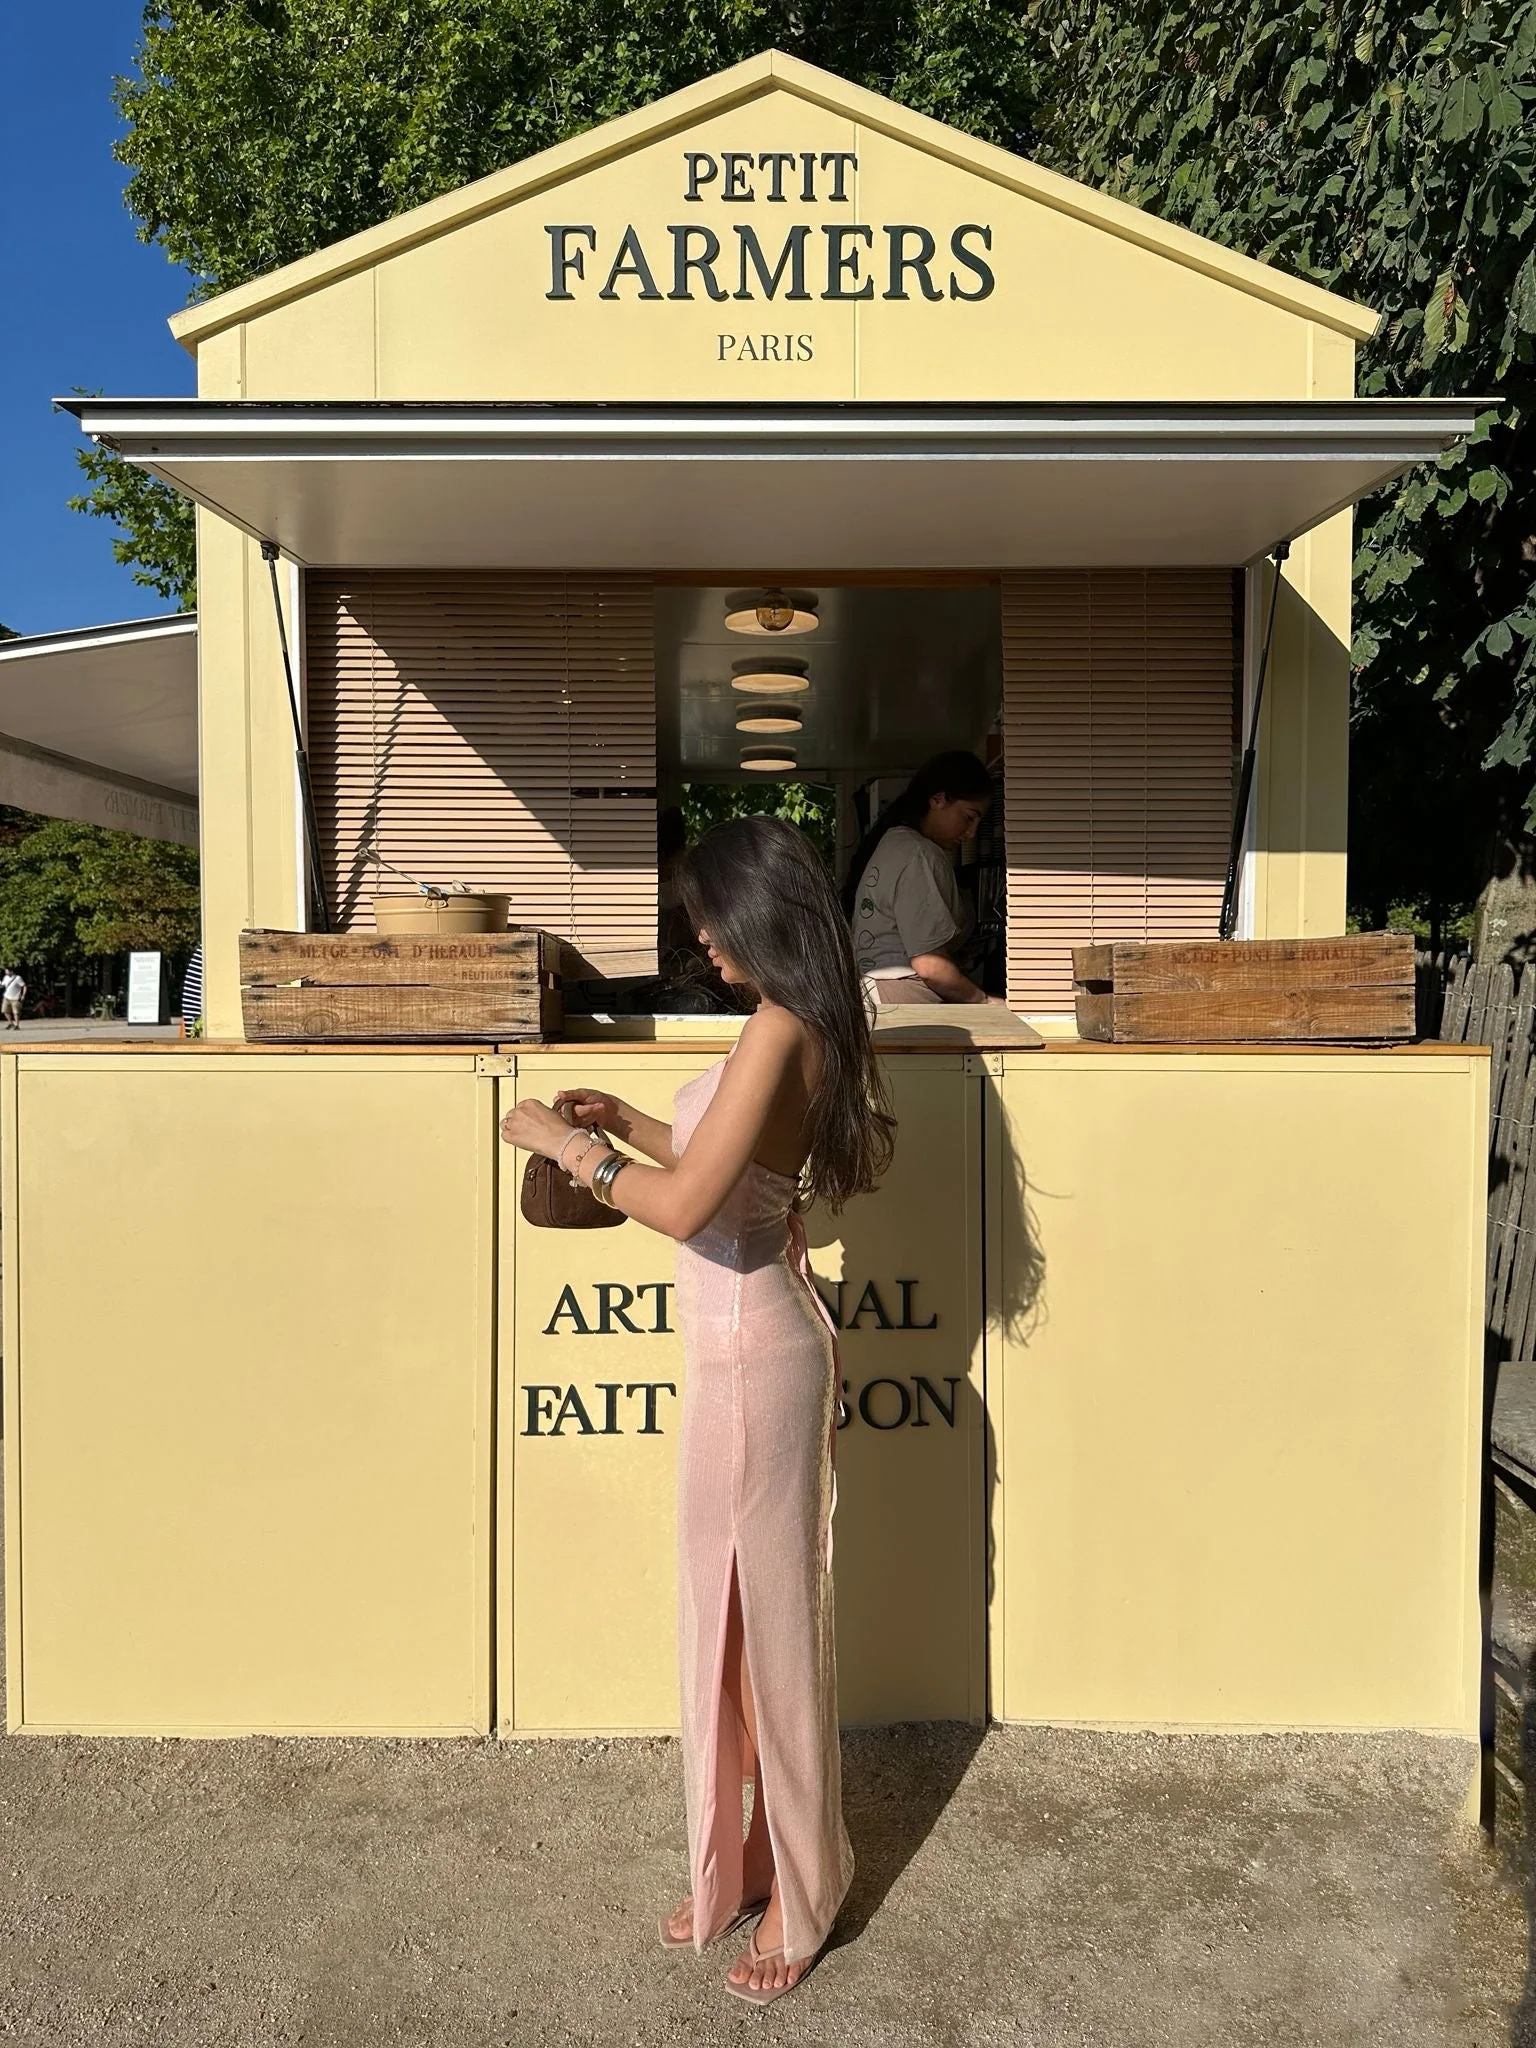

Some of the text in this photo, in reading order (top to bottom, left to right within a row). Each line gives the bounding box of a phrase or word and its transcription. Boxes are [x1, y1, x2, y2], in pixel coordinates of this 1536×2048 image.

[683, 152, 858, 202] PETIT
[544, 224, 996, 302] FARMERS
[716, 334, 814, 362] PARIS
[542, 1280, 938, 1335] ARTNAL
[520, 1382, 677, 1436] FAIT
